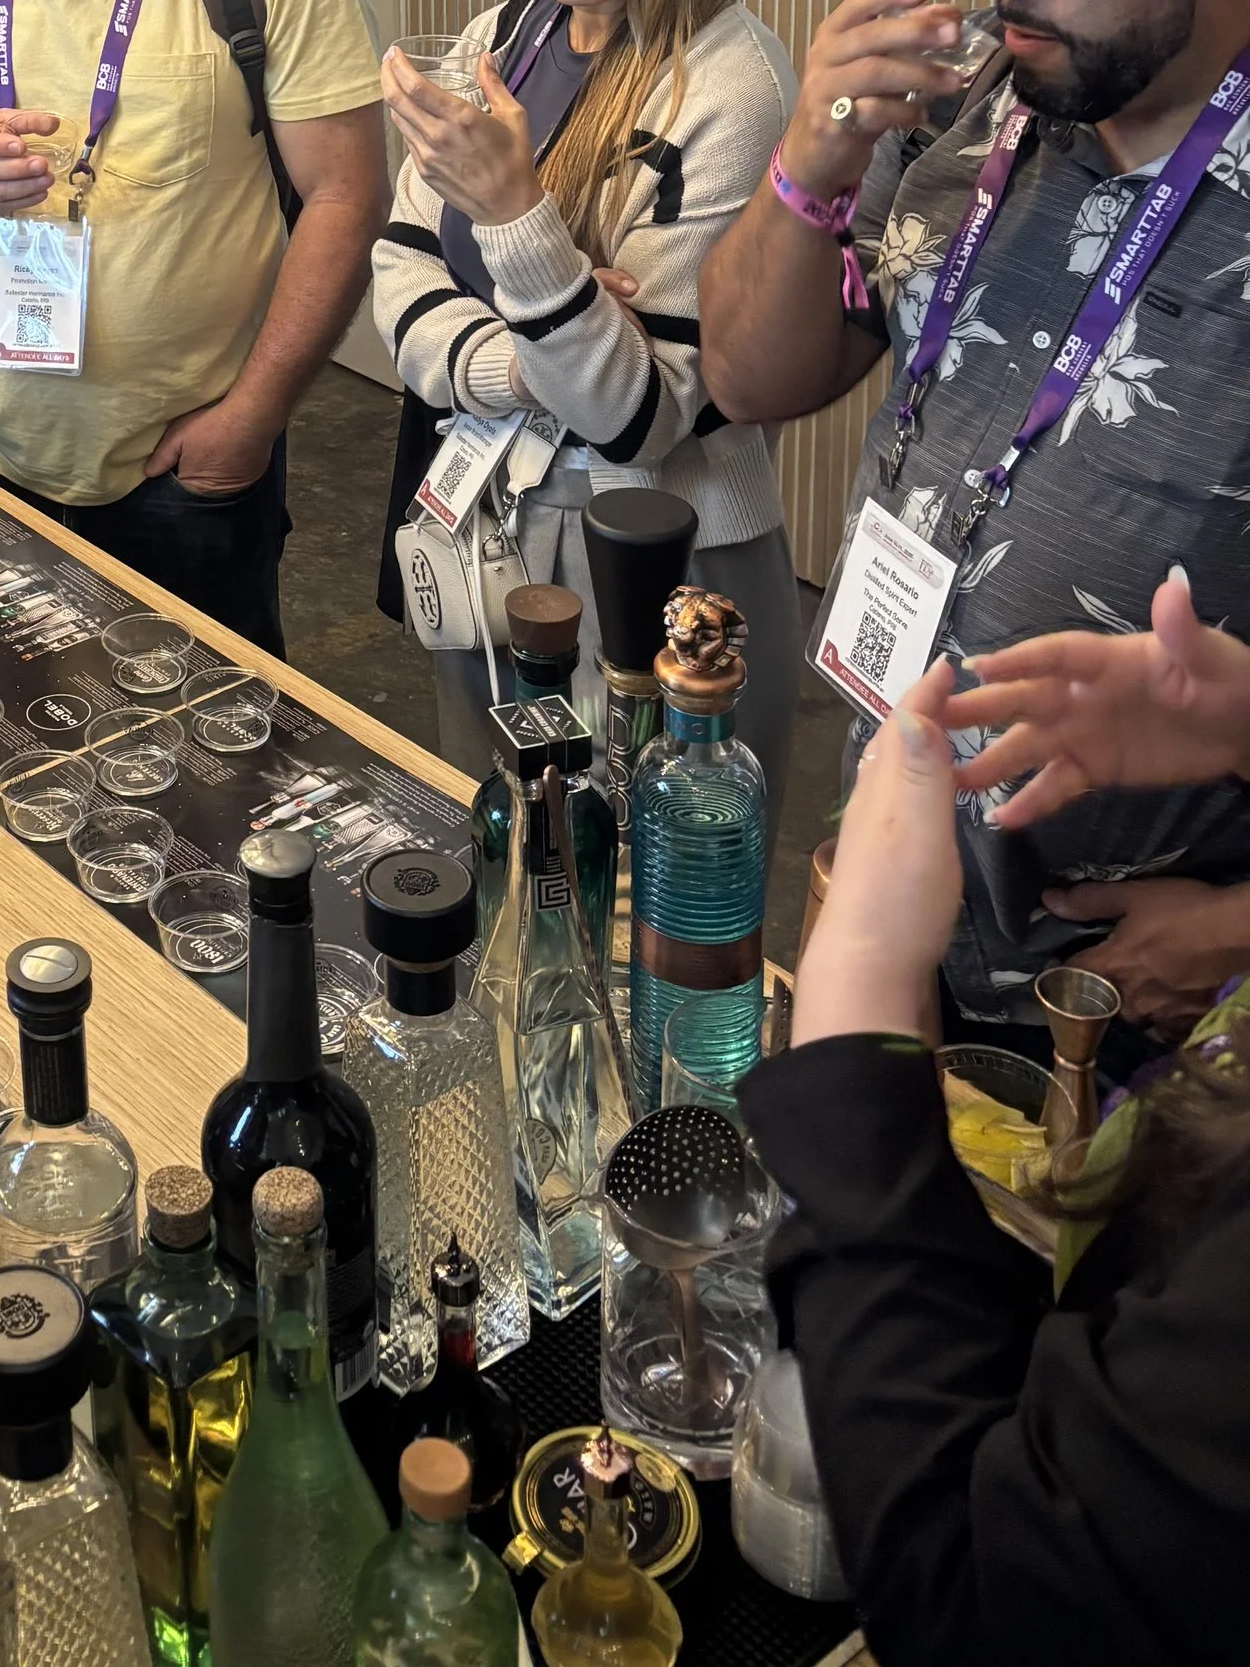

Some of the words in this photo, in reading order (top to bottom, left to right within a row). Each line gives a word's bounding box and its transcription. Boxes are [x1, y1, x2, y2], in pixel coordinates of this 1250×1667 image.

[0, 15, 9, 86] SMARTTAB
[96, 63, 110, 90] BCB
[1210, 70, 1243, 108] BCB
[1007, 115, 1027, 151] BCB
[1110, 183, 1172, 283] SMARTTAB
[943, 206, 989, 303] SMARTTAB
[1054, 334, 1082, 373] BCB
[872, 556, 890, 577] Ariel
[890, 569, 919, 600] Rosario
[825, 648, 833, 664] A
[839, 667, 869, 698] ATTENDEE
[869, 691, 881, 705] ALL
[44, 700, 78, 726] DOBEL
[190, 939, 225, 965] 1800
